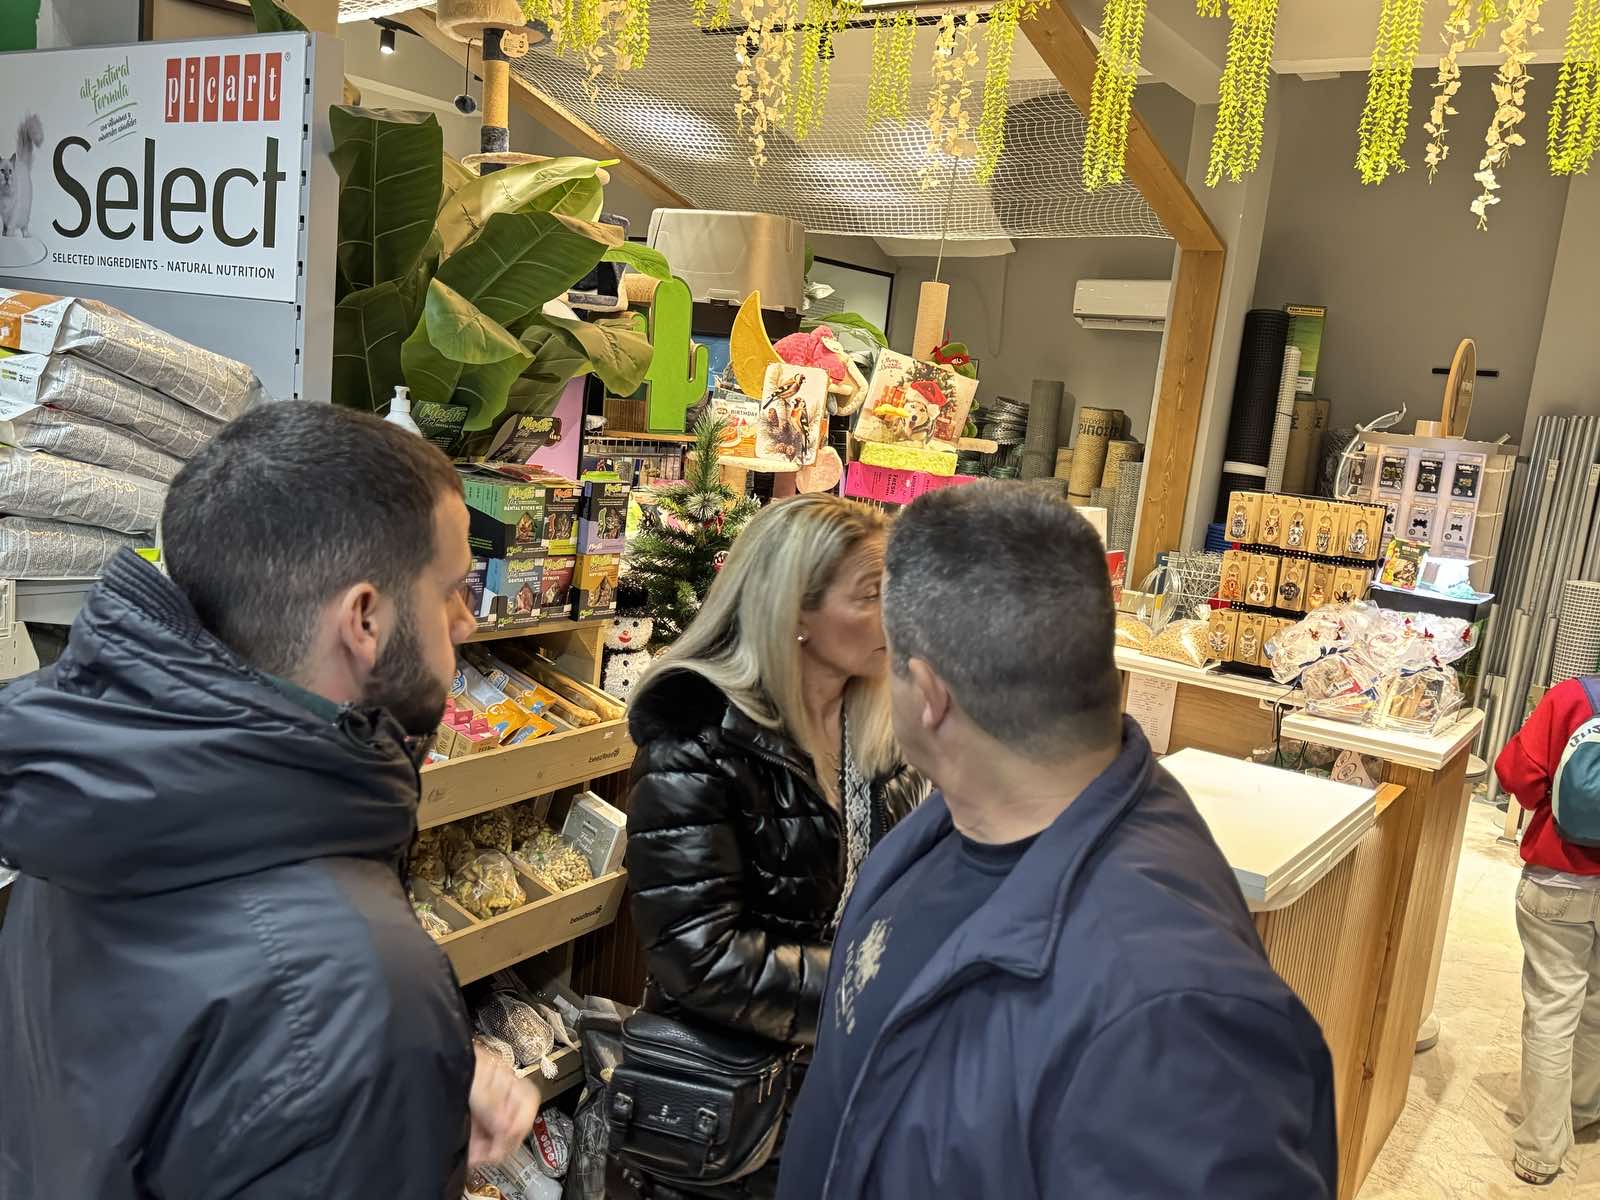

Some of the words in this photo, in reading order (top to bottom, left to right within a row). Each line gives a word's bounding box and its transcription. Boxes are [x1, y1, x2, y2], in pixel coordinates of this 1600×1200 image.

[91, 81, 129, 115] formula
[166, 64, 278, 118] picart
[52, 136, 286, 248] Select
[52, 252, 95, 266] SELECTED
[97, 256, 158, 271] INGREDIENTS
[167, 261, 213, 276] NATURAL
[216, 264, 275, 280] NUTRITION
[730, 409, 758, 417] BIRTHDAY
